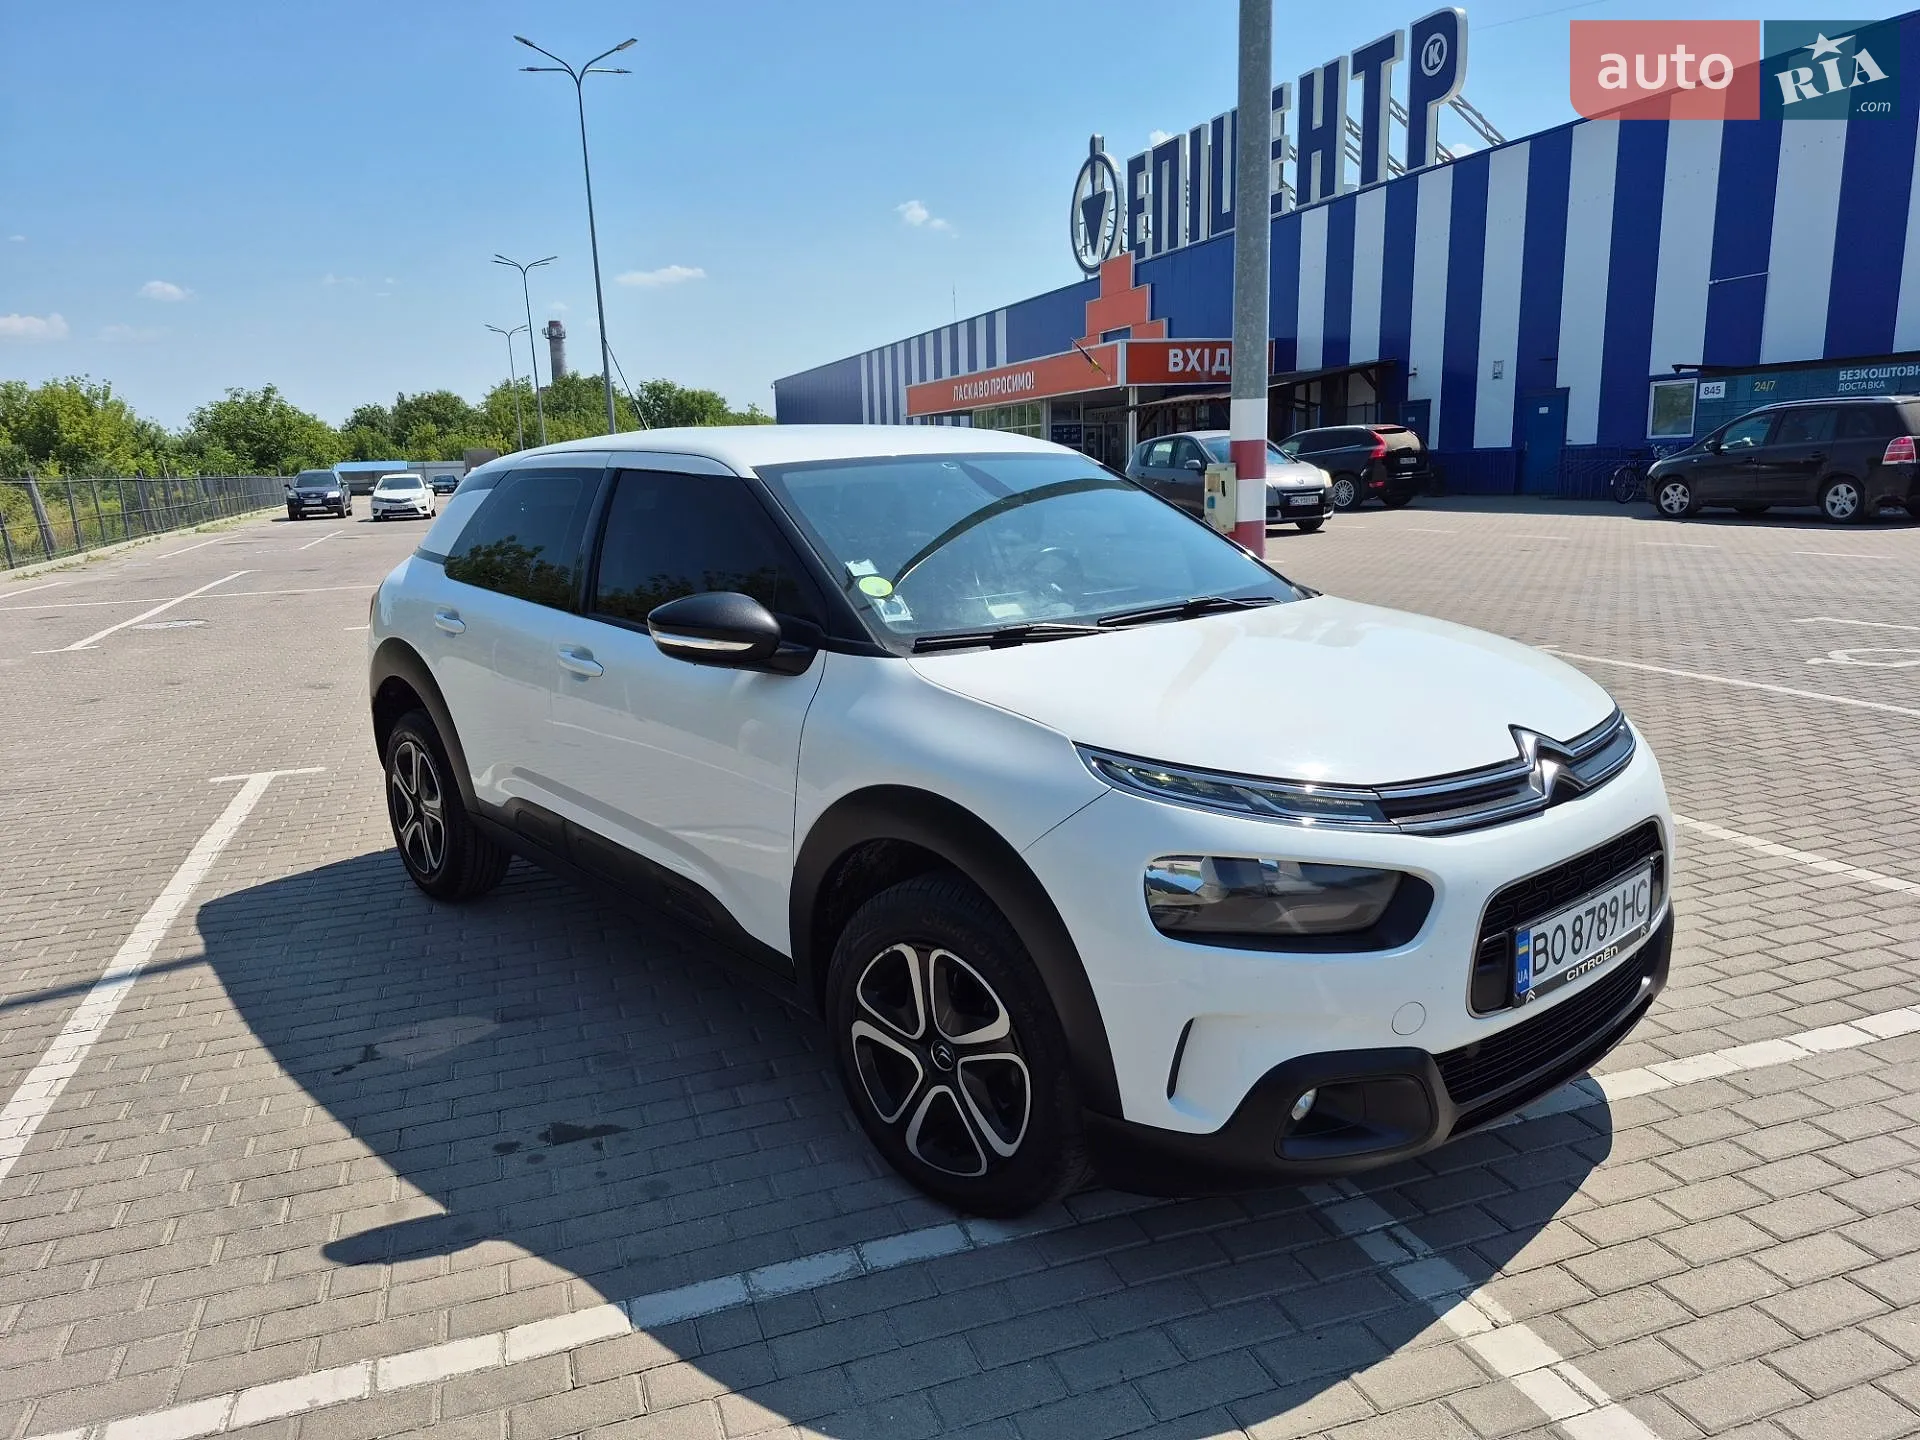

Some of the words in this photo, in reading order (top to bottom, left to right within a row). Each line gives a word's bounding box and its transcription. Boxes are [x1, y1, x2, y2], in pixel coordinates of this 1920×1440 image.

[1168, 348, 1231, 376] ВХІД
[953, 379, 990, 402] ЛАСКАВО
[990, 371, 1035, 396] ПРОСИМО!
[1703, 386, 1721, 396] 845
[1753, 380, 1776, 392] 24/7
[1838, 381, 1885, 393] ДОСТАВКА
[1517, 969, 1529, 984] UA
